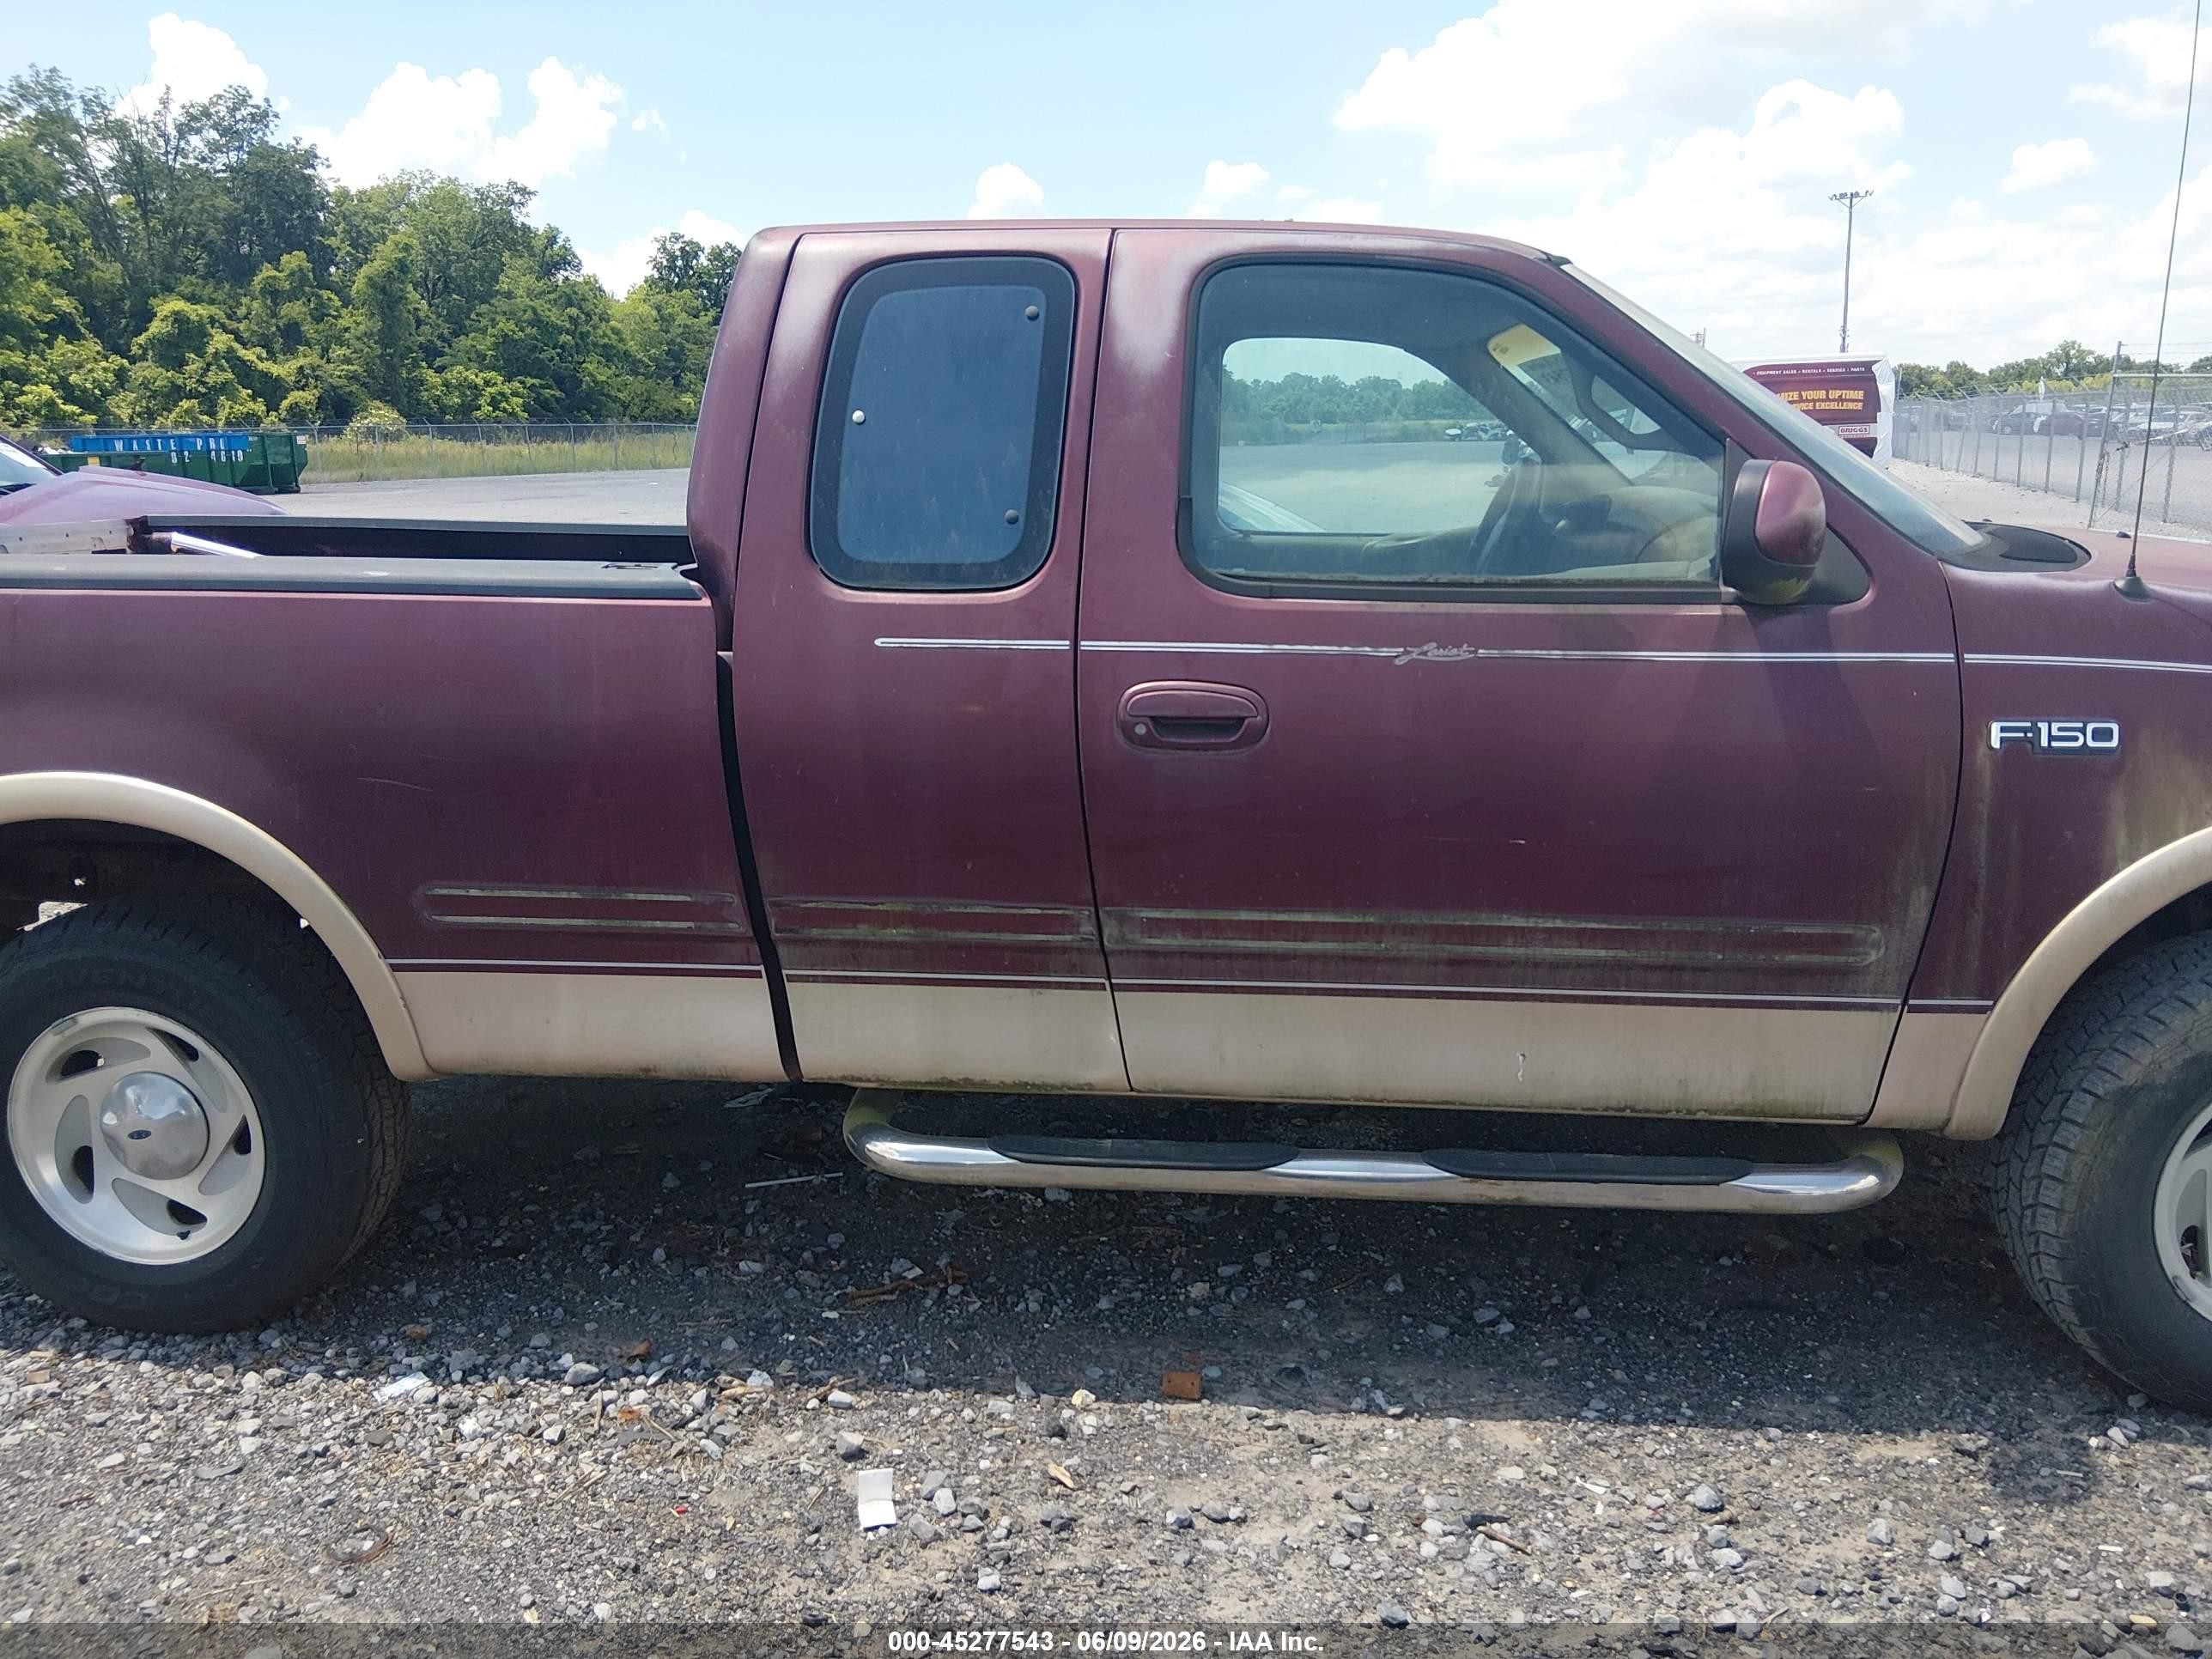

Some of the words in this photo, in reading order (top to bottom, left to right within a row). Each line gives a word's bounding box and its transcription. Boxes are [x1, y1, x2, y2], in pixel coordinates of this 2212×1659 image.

[1802, 391, 1826, 399] YOUR
[1828, 390, 1864, 400] UPTIME
[1815, 402, 1863, 410] EXCELLENCE
[113, 439, 177, 452] WASTE
[1990, 721, 2120, 750] F-150
